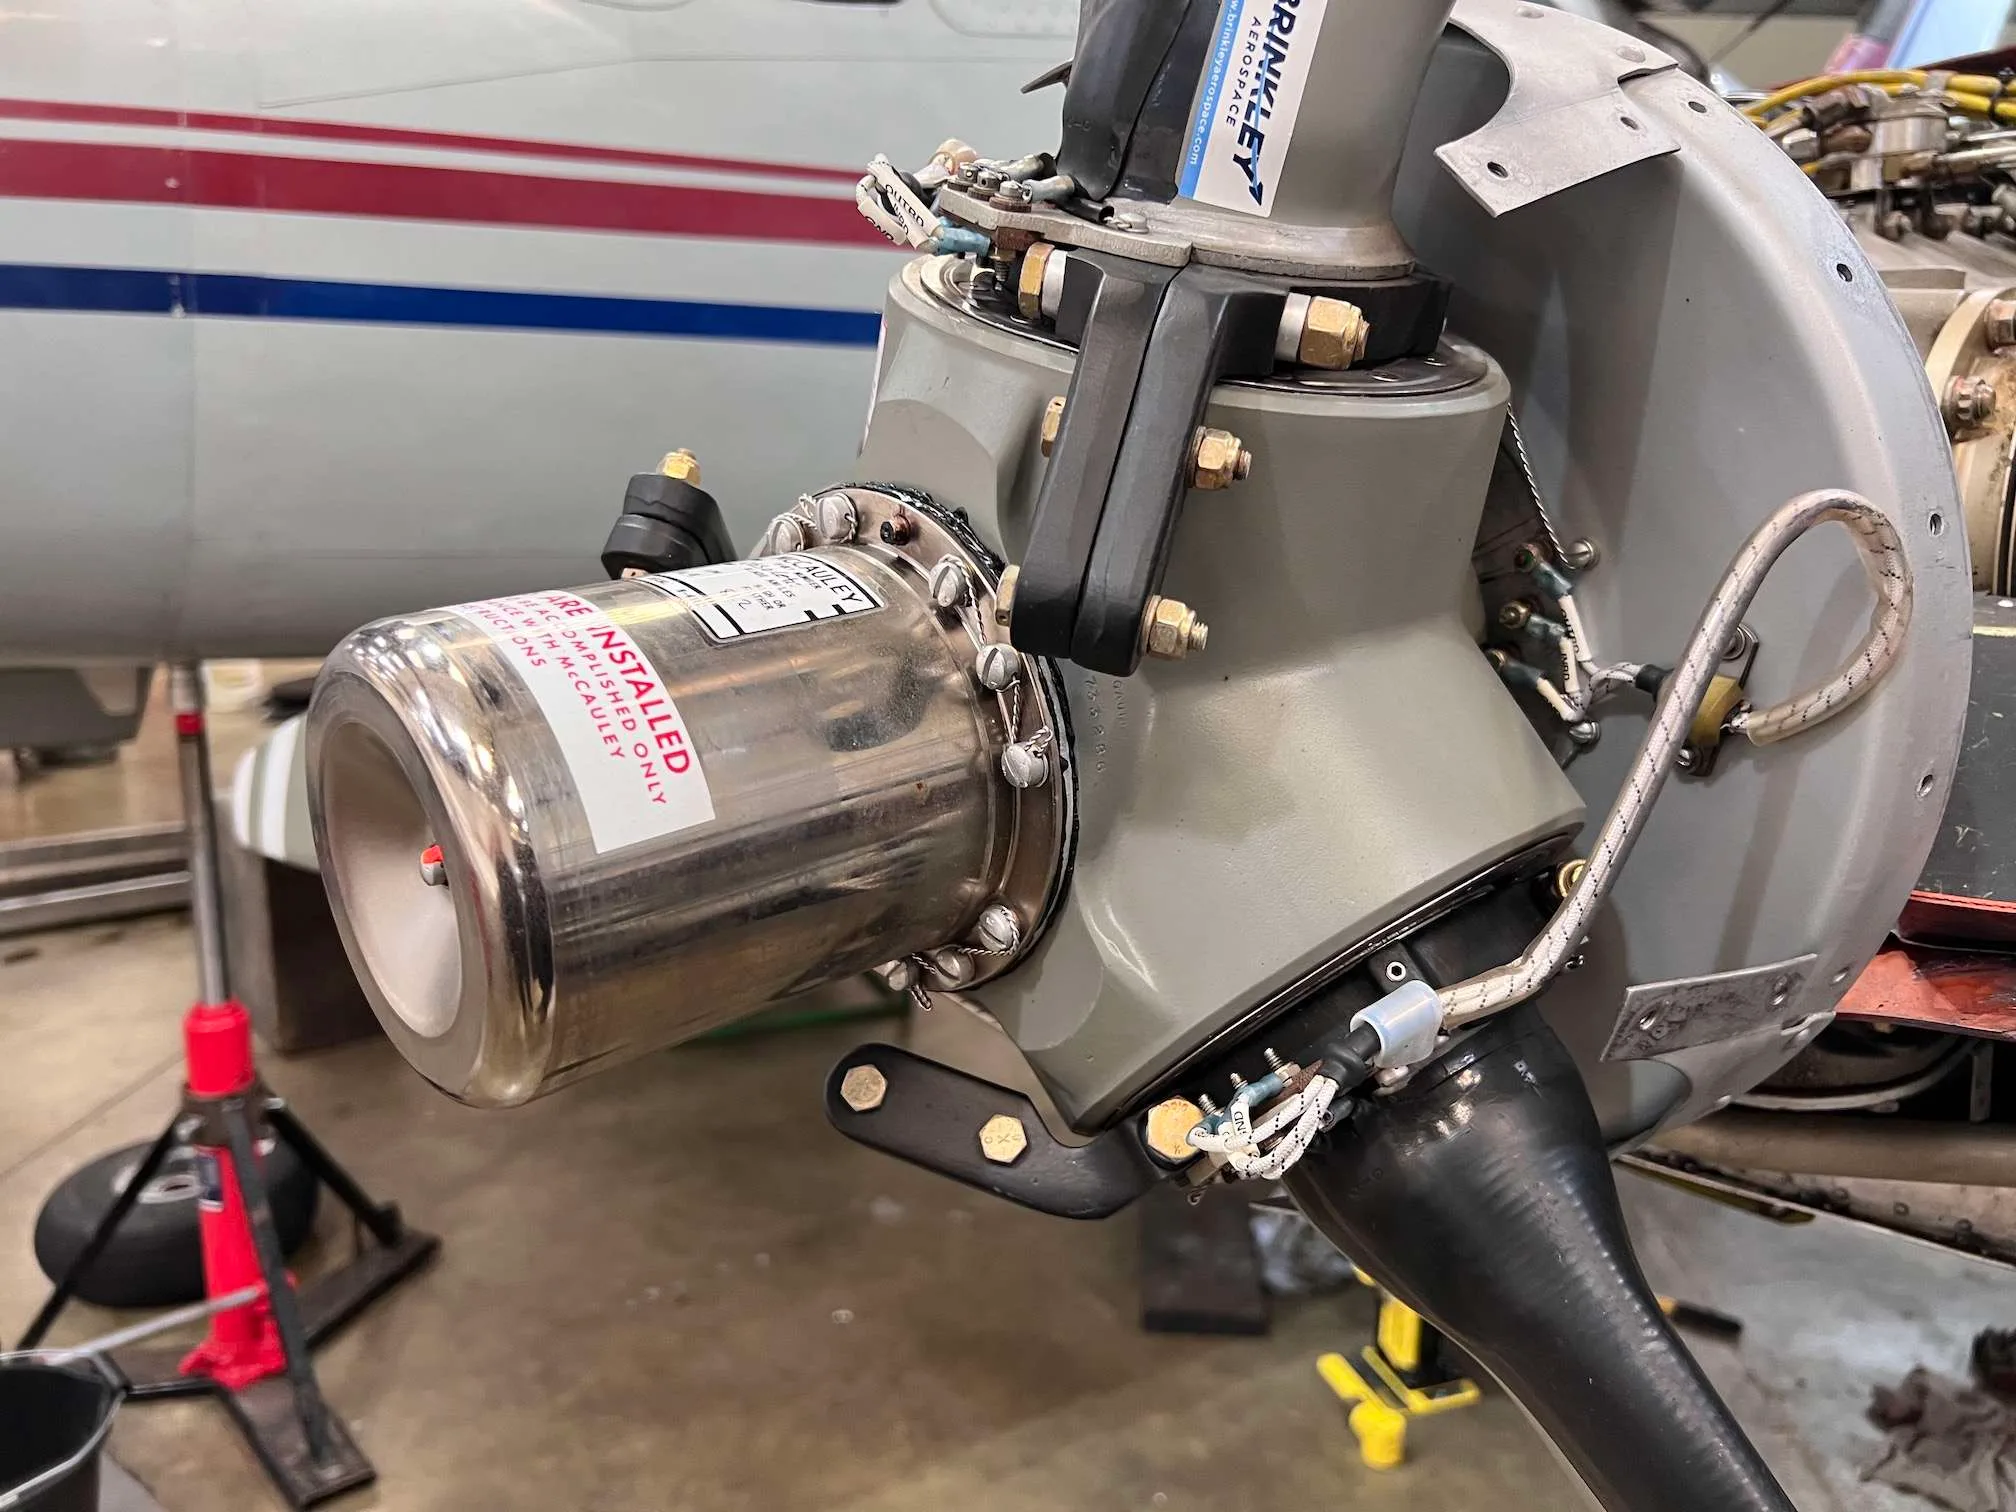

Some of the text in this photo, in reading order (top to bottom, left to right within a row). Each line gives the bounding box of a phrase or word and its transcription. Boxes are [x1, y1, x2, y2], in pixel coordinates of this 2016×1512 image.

[1226, 16, 1261, 127] AEROSPACE
[1232, 0, 1300, 206] RINKLEY
[522, 617, 560, 649] WTH
[557, 656, 625, 759] McCAULEY
[536, 609, 637, 733] ACOMPLISHED
[634, 742, 667, 805] ONLY
[540, 595, 593, 617] ARE
[586, 625, 691, 774] INSTALLED
[1233, 1110, 1247, 1134] ND
